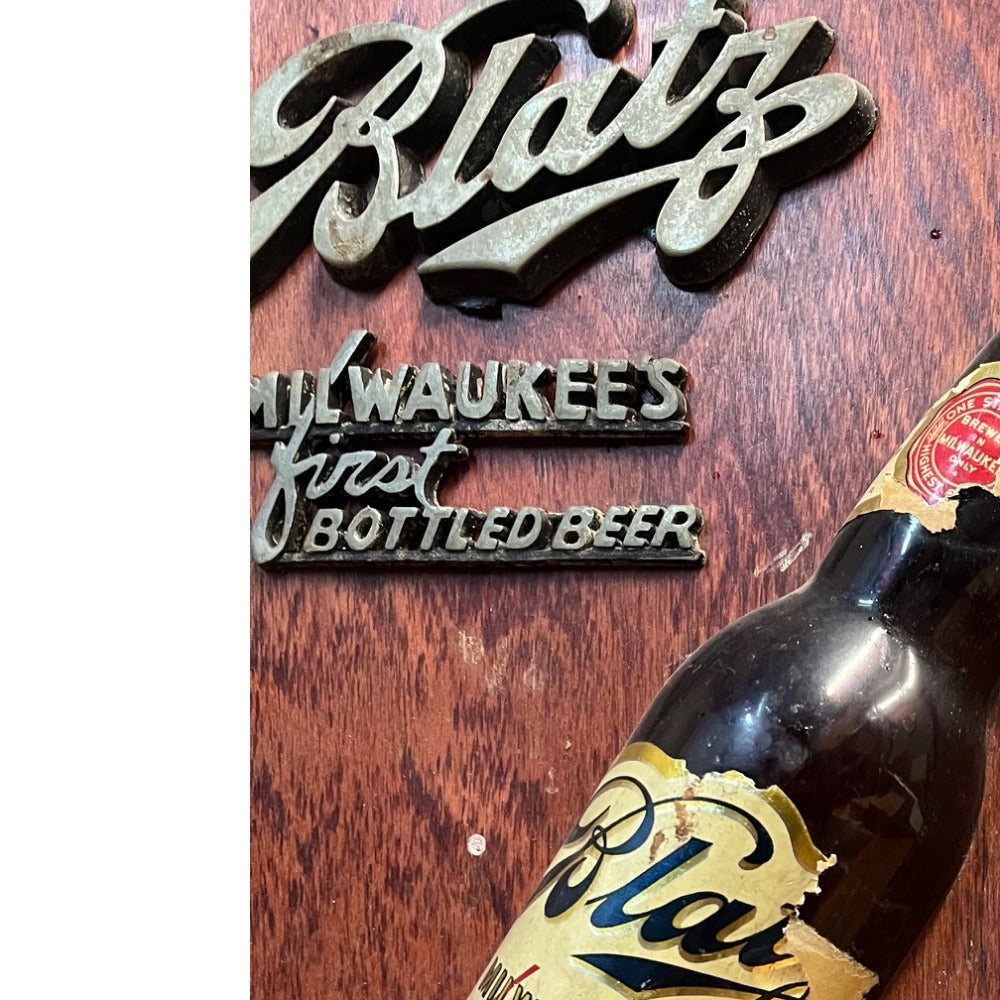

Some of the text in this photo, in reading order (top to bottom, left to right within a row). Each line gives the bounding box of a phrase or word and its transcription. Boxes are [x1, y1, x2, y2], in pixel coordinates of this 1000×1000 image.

[946, 397, 976, 421] ONE
[252, 329, 460, 563] first
[949, 454, 977, 473] ONLY
[302, 503, 700, 552] BOTTLED BEER
